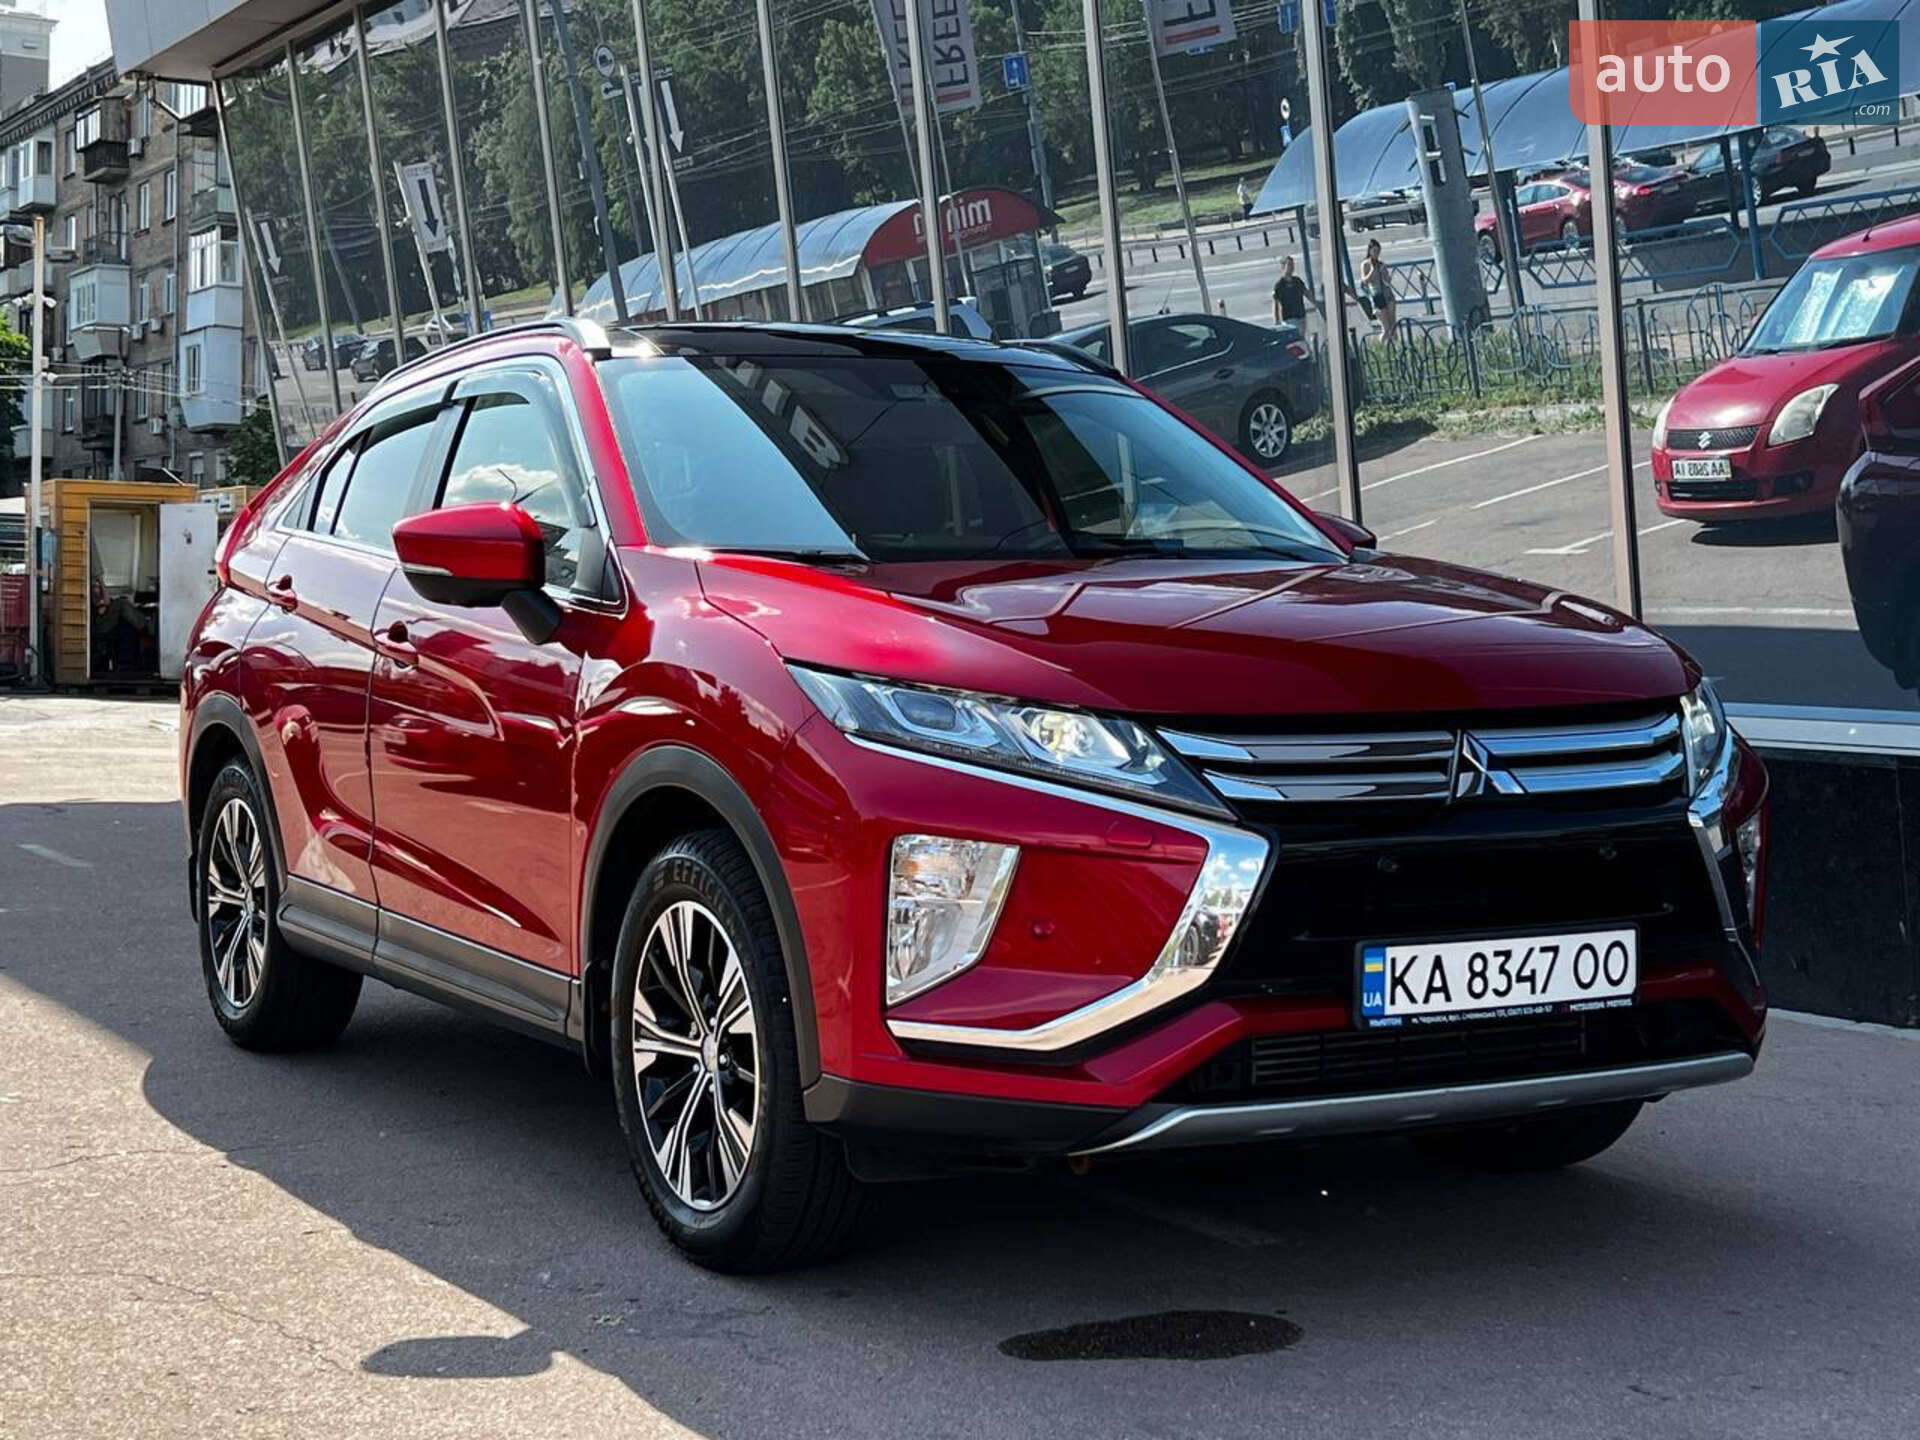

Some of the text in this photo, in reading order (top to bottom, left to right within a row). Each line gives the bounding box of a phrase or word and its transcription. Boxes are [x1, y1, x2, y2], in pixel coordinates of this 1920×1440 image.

[1389, 954, 1453, 1006] KA
[1467, 944, 1561, 1000] 8347
[1363, 991, 1383, 1008] UA
